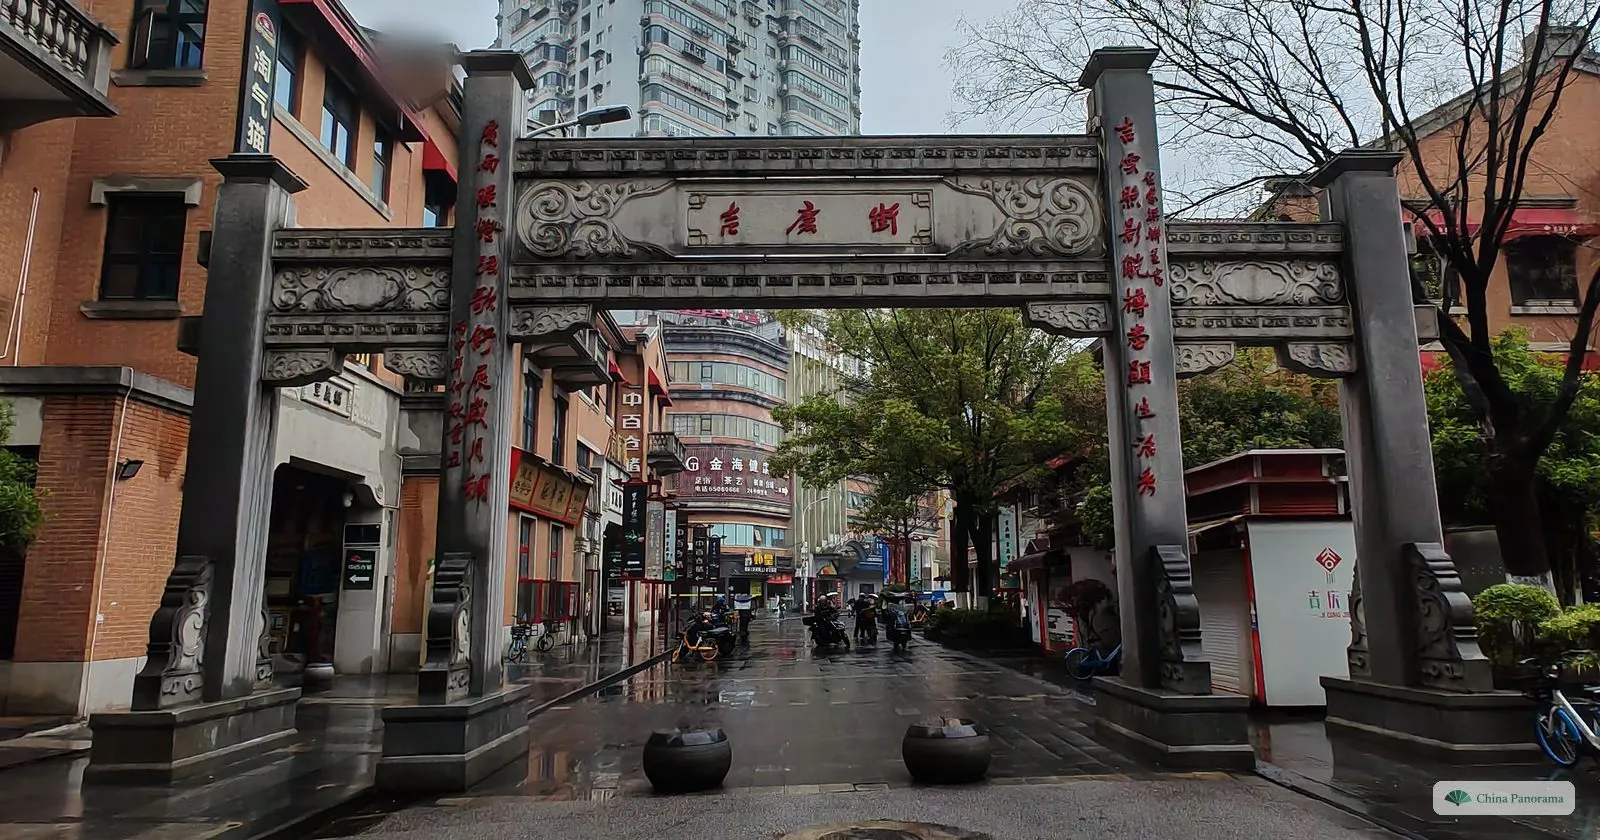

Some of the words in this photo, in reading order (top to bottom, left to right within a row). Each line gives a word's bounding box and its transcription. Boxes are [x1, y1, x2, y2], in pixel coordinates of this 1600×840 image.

[247, 45, 272, 153] 淘气猫
[1307, 590, 1352, 610] 吉庆
